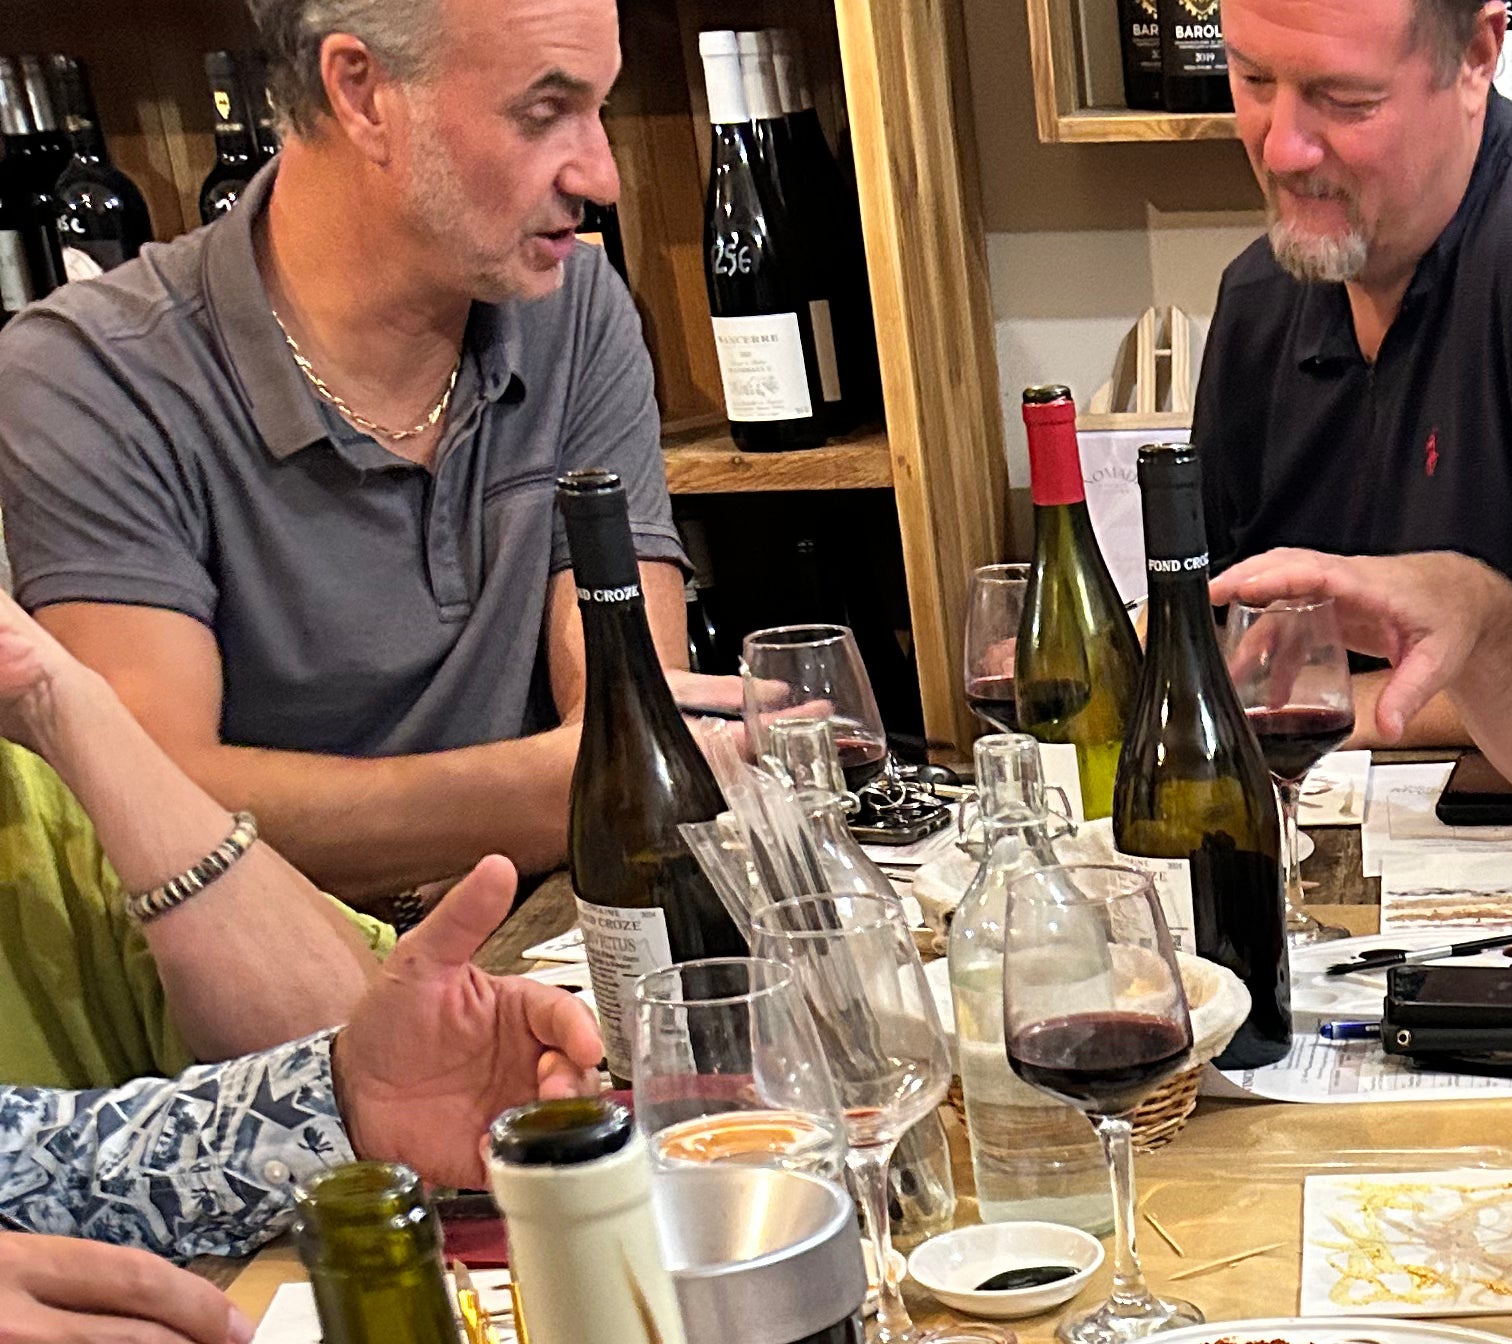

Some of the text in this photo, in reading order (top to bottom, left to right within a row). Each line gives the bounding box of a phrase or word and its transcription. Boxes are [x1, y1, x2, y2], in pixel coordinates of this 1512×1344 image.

[1133, 24, 1159, 36] BAR
[1175, 25, 1222, 38] BAROL
[1148, 552, 1210, 572] FOND CRO
[593, 584, 640, 603] CROZE
